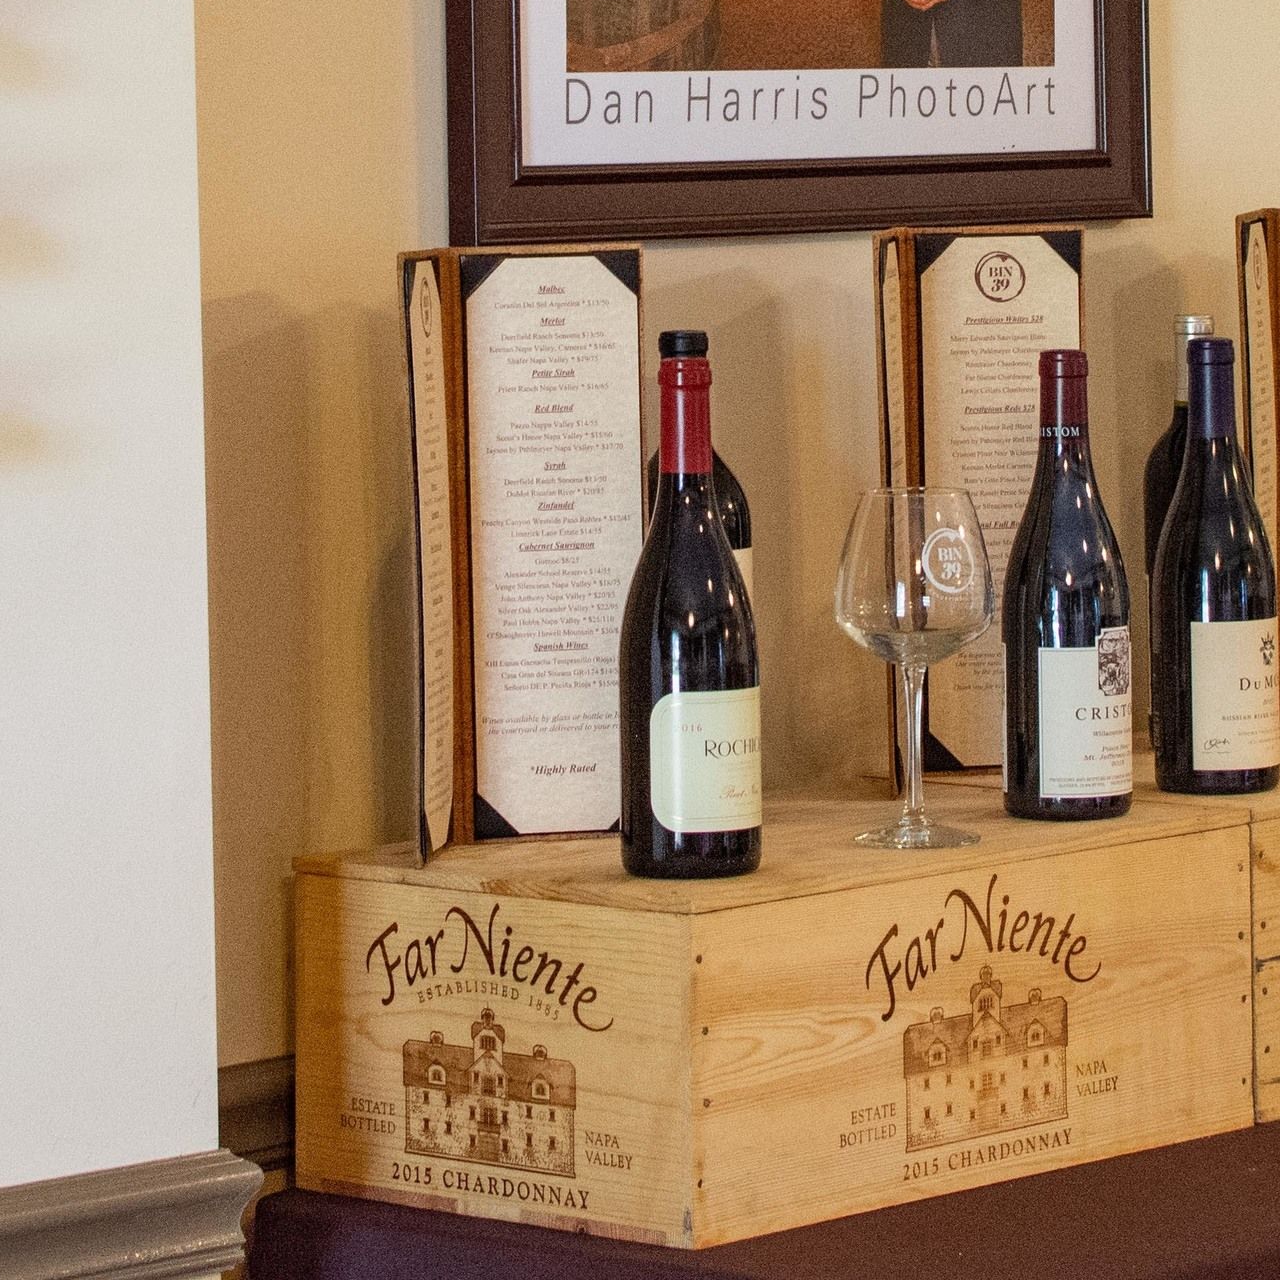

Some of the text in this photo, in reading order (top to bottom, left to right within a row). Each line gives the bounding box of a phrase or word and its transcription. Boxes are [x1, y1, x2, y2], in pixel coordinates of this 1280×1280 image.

[565, 71, 1057, 125] Dan Harris PhotoArt
[989, 266, 1013, 277] BIN
[991, 279, 1010, 292] 39
[540, 317, 565, 327] Merlot
[532, 368, 575, 379] Petite Sirah
[534, 403, 573, 414] Red Blend
[553, 420, 574, 429] Valley
[1040, 426, 1080, 437] ISTOM
[562, 433, 583, 441] Valley
[544, 461, 566, 471] Syrah
[537, 501, 575, 511] Zinfandel
[519, 541, 595, 552] Cabernet Sauvignon
[937, 547, 962, 561] BIN
[941, 561, 962, 580] 39
[533, 640, 589, 652] Spanish Wines
[569, 763, 596, 773] Rated
[865, 872, 1103, 1022] Far Niente
[365, 902, 615, 1033] Far Niente
[416, 978, 561, 1022] ESTABLISHED 1885
[1074, 1059, 1109, 1078] NAPA
[1075, 1074, 1120, 1099] VALLEY
[350, 1096, 397, 1117] ESTATE
[849, 1102, 898, 1127] ESTATE
[339, 1113, 397, 1136] BOTTLED
[583, 1130, 621, 1151] NAPA
[838, 1123, 898, 1150] BOTTLED
[584, 1149, 634, 1171] VALLEY
[902, 1127, 1075, 1182] 2015 CHARDONNAY
[391, 1161, 591, 1211] 2015 CHARDONNAY
